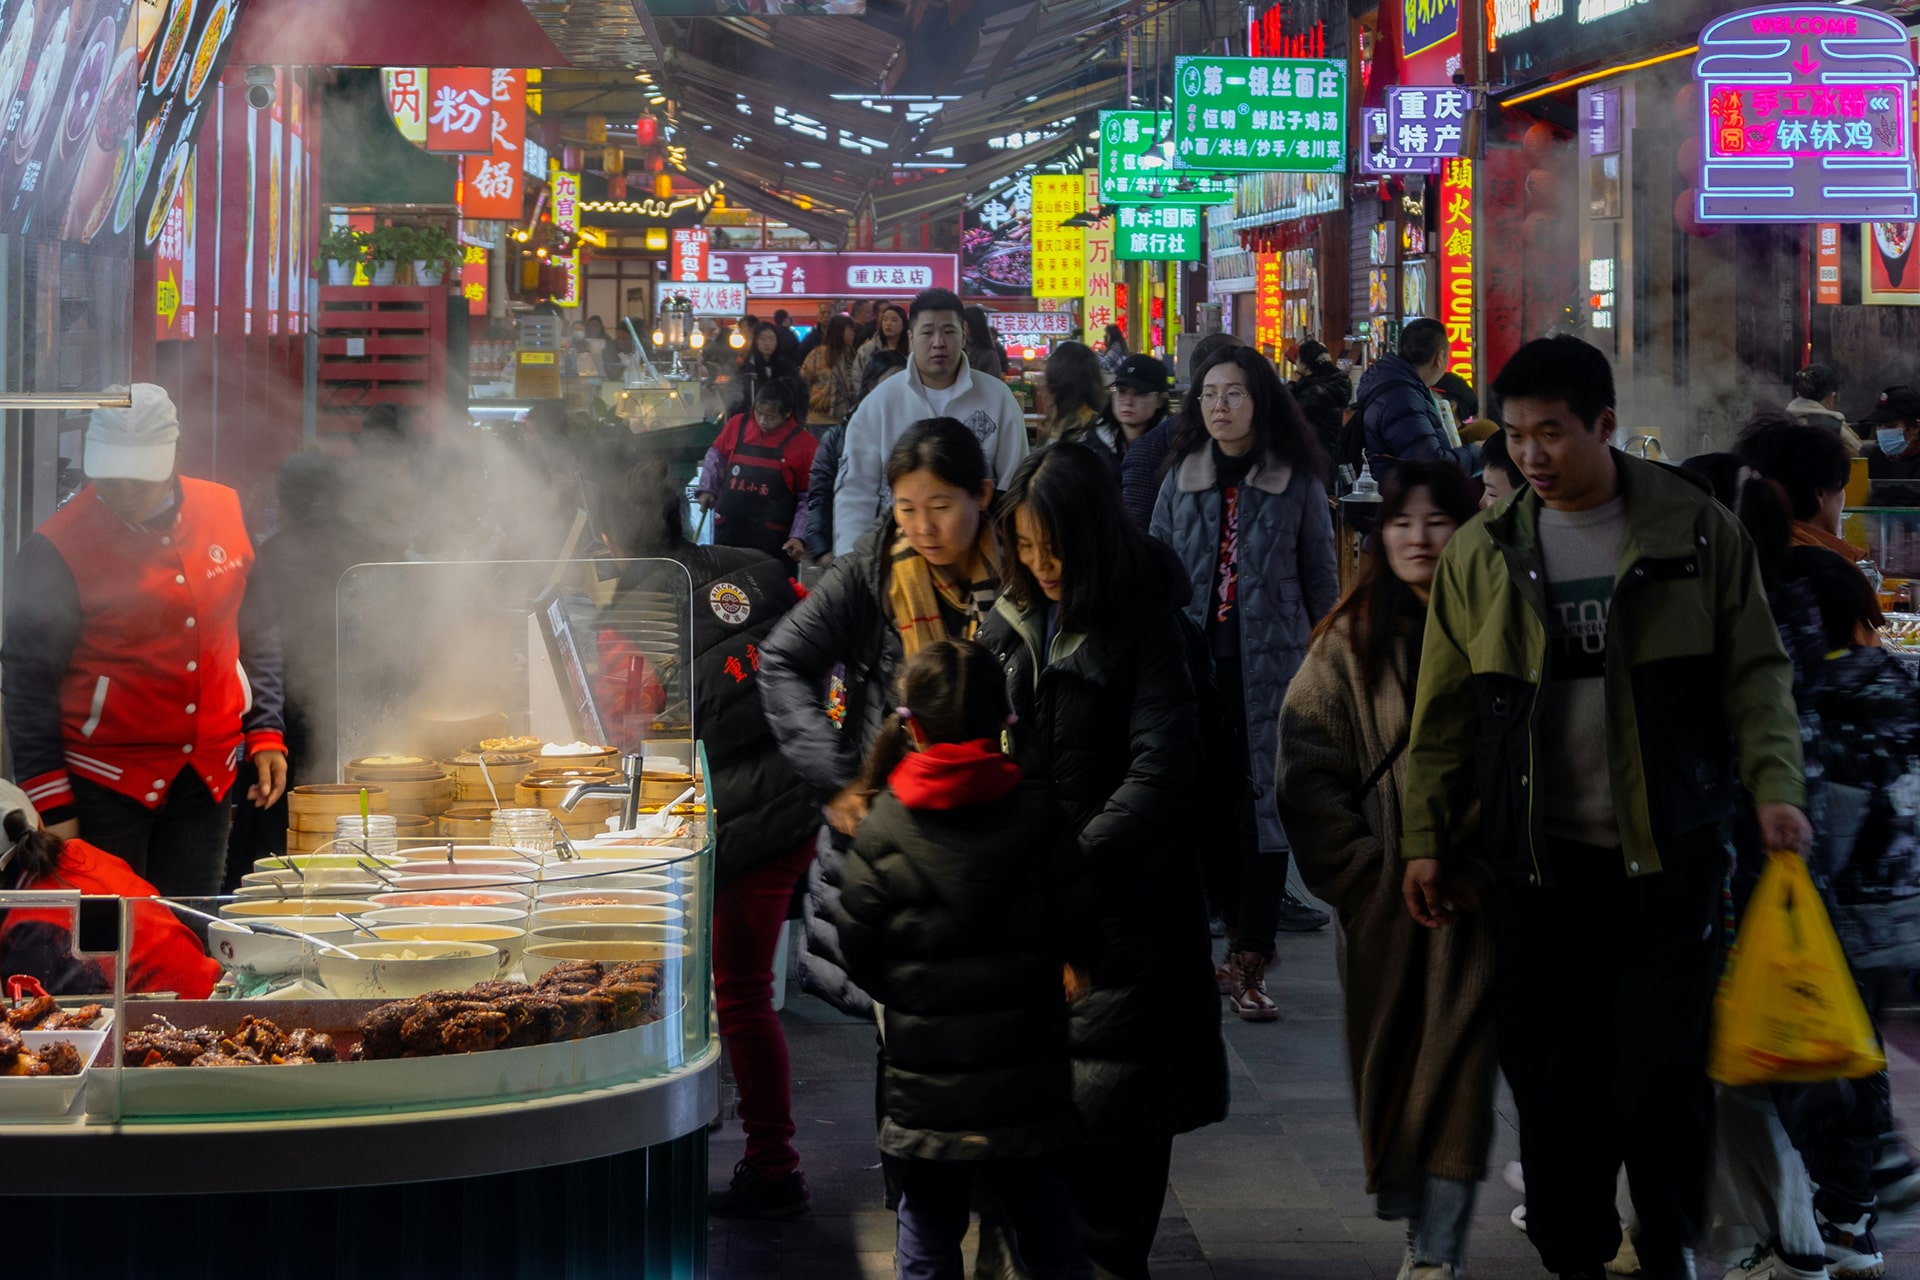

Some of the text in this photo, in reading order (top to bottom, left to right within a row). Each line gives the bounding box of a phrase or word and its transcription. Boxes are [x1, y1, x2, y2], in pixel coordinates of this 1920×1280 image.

[1751, 16, 1858, 35] WELCOME
[1203, 65, 1339, 98] 第一银丝面庄
[429, 85, 490, 133] 粉
[1398, 91, 1462, 119] 重庆
[1751, 89, 1867, 118] 手工冰粉
[1252, 110, 1338, 131] 鲜肚子鸡汤
[1721, 91, 1744, 151] 冰汤圆
[1398, 124, 1462, 153] 特产
[1777, 119, 1873, 150] 钵钵鸡
[1180, 136, 1341, 158] 小面/米线/抄手/老川菜
[675, 230, 707, 242] 巫山
[1130, 233, 1186, 253] 旅行社
[855, 269, 925, 284] 重庆总店
[991, 315, 1068, 331] 正宗炭火烧烤
[711, 583, 748, 600] AIRCRAFT
